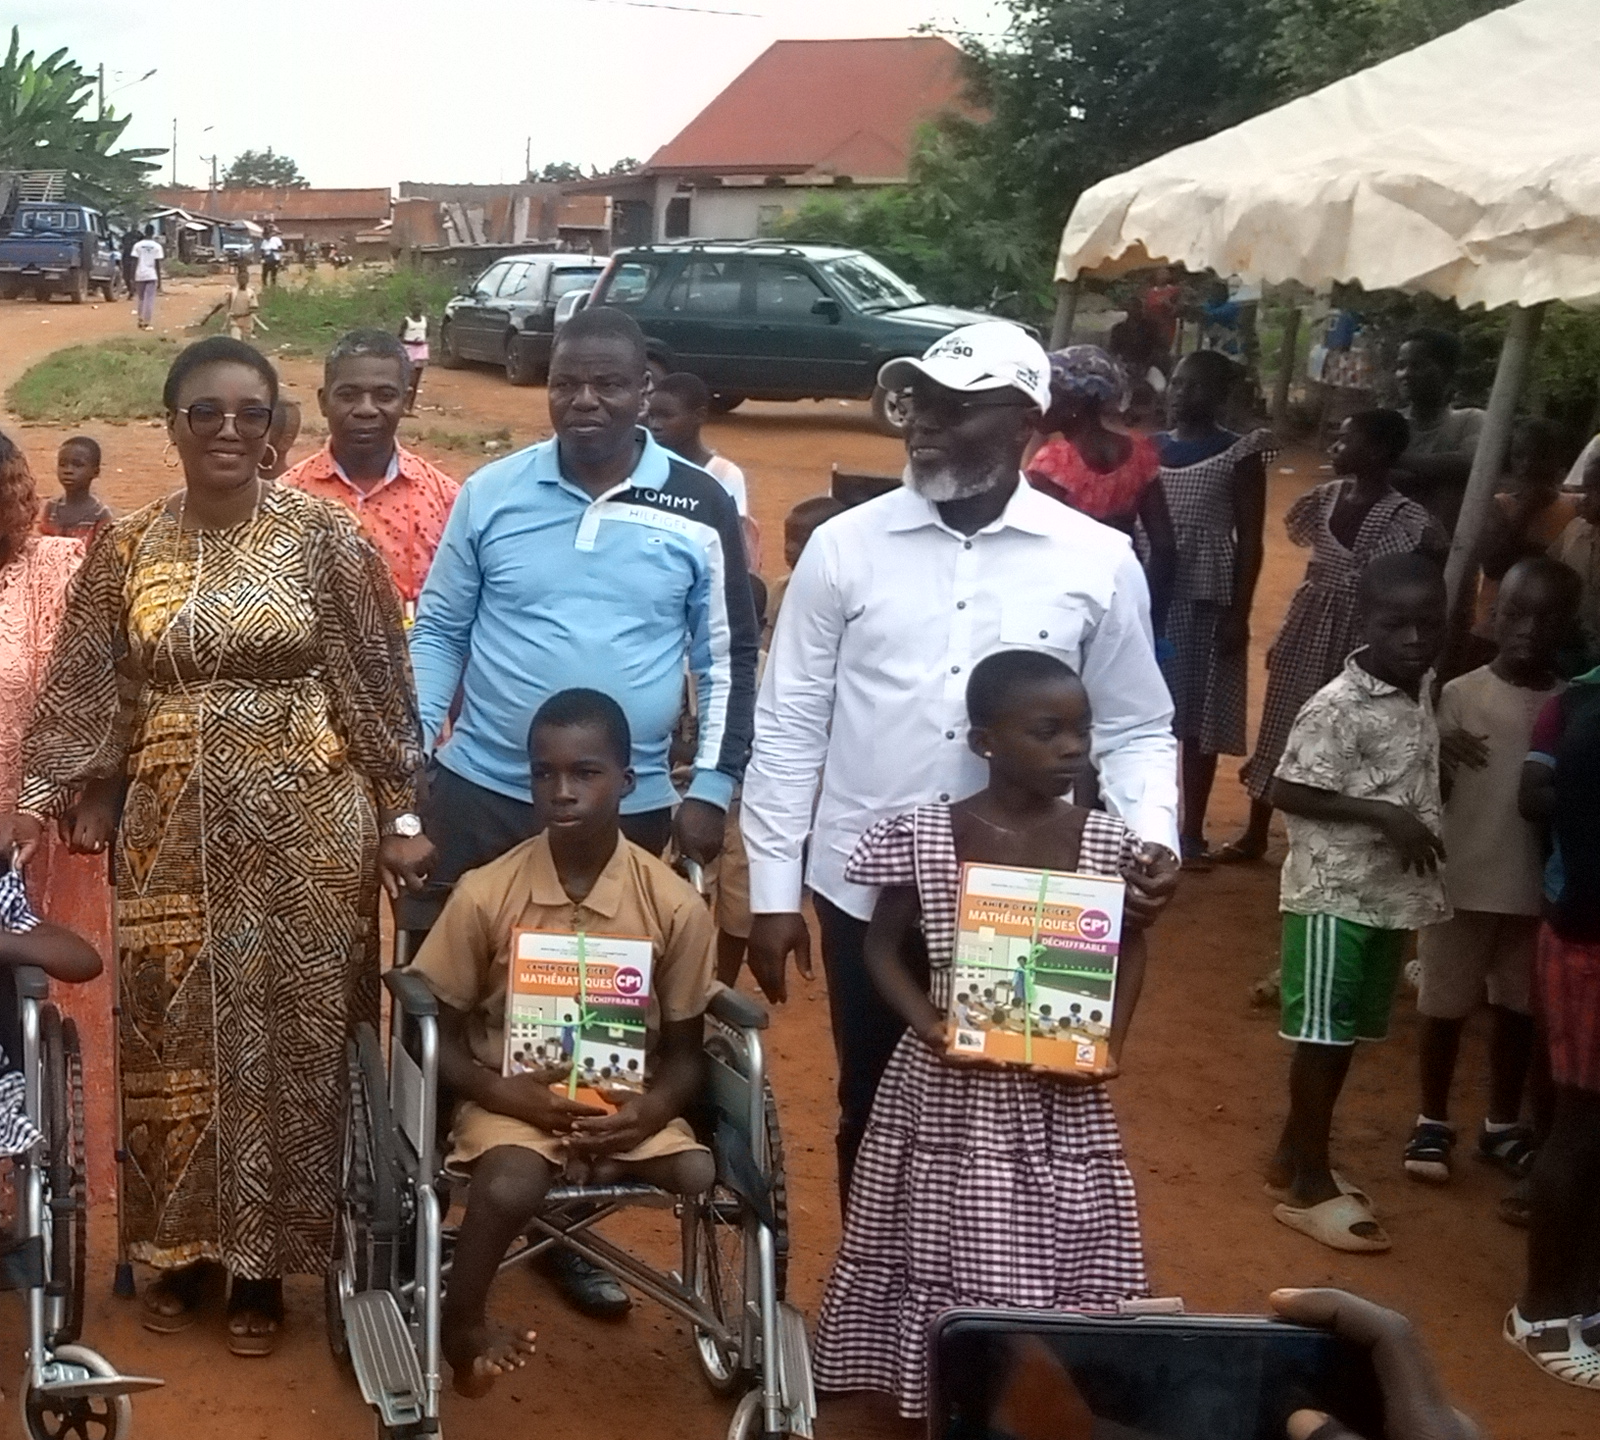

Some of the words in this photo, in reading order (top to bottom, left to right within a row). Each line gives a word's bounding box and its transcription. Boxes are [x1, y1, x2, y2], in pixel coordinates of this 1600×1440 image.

[1080, 917, 1109, 934] CP1
[1042, 935, 1107, 952] DÉCHIFFRABLE
[519, 971, 613, 989] MATHÉMATQUES
[616, 974, 642, 988] CP1
